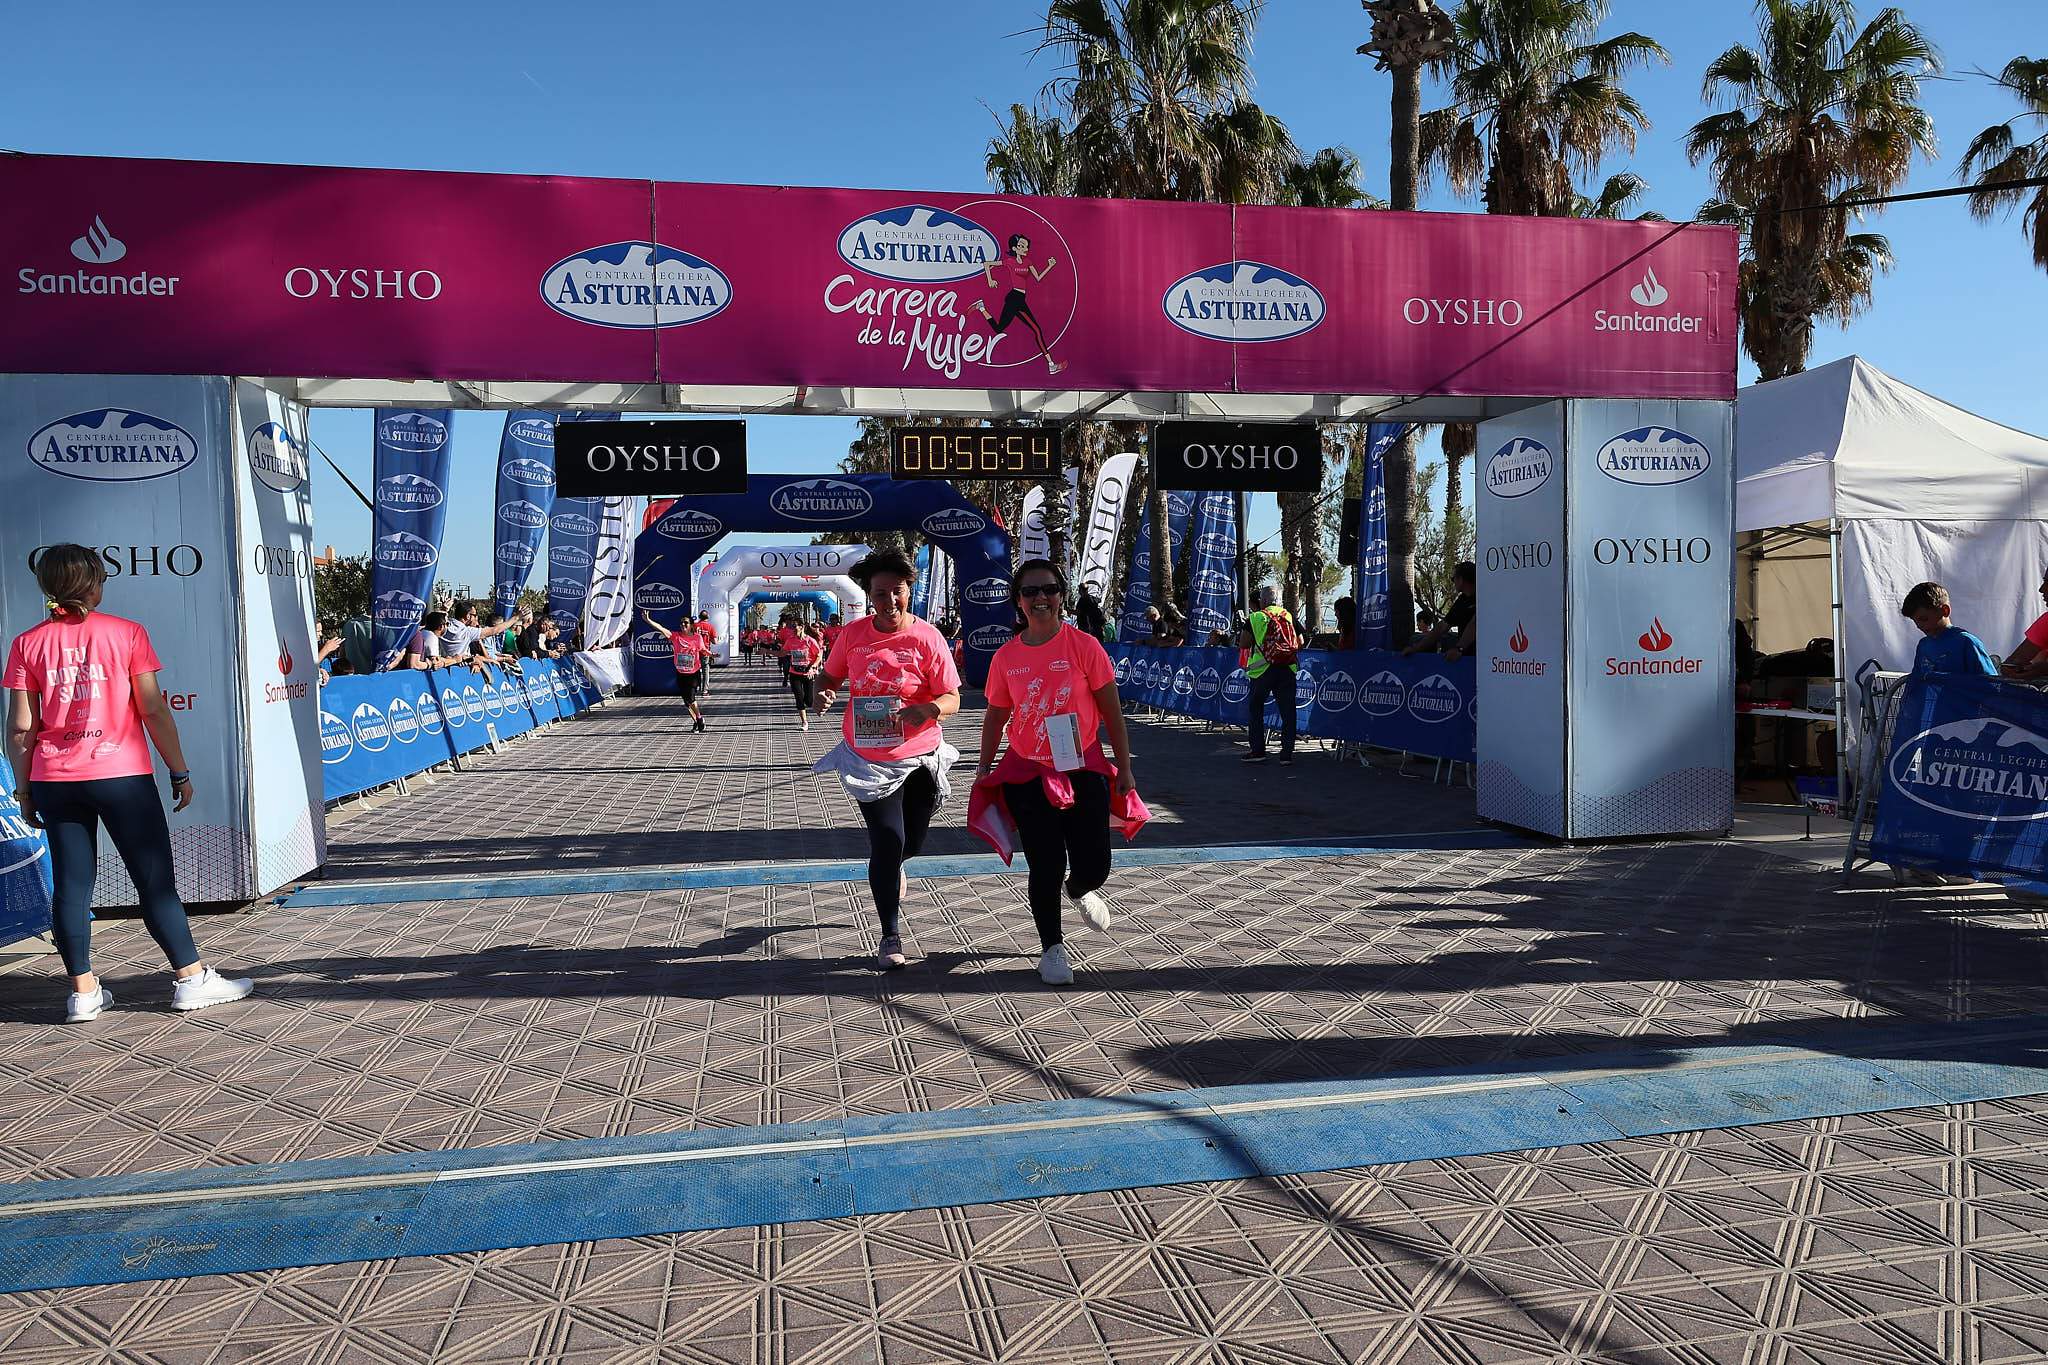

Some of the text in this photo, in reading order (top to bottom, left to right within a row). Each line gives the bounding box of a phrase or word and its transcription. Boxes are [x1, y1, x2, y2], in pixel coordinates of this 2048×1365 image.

[875, 230, 983, 242] CENTRAL LECHERA
[851, 231, 988, 264] ASTURIANA
[17, 268, 180, 296] Santander
[284, 267, 442, 300] OYSHO
[585, 271, 645, 280] CENTRAL
[556, 271, 719, 306] ASTURIANA
[824, 274, 958, 318] Carrera
[1201, 288, 1308, 298] CENTRAL LECHERA
[1176, 288, 1314, 322] ASTURIANA
[1402, 297, 1523, 326] OYSHO
[1594, 310, 1702, 333] Santander
[857, 314, 1007, 380] de la Mujer
[67, 433, 180, 442] CENTRAL LECHERA
[381, 426, 443, 444] ASTURIAN
[513, 424, 554, 443] ASTURIA
[41, 435, 186, 464] ASTURIANA
[586, 445, 721, 473] OYSHO
[903, 435, 1049, 470] 00:56:54
[1183, 443, 1299, 470] OYSHO
[1604, 447, 1702, 471] ASTURIANA
[1661, 446, 1699, 454] LECHERA
[1489, 462, 1548, 487] ASTURIANA
[778, 492, 865, 511] ASTURIANA
[554, 518, 595, 533] ASTURIANA
[660, 520, 717, 534] ASTURIANA
[927, 520, 981, 532] ASTURIANA
[28, 545, 204, 577] SHO
[254, 544, 308, 579] OYSHO
[760, 551, 841, 569] OYSHO
[1486, 541, 1552, 572] OYSHO
[1593, 537, 1712, 565] OYSHO
[552, 586, 585, 596] STURIANA
[635, 593, 681, 605] ASTURIANA
[968, 588, 1011, 599] ASTURIAN
[636, 641, 675, 653] ASTURIAN
[971, 634, 1016, 646] ASTURIAN
[63, 648, 86, 665] TU
[1491, 656, 1547, 677] Santander
[1605, 656, 1703, 677] Santander
[46, 663, 109, 687] DORSAL
[1007, 667, 1031, 676] OYSHO
[59, 686, 102, 704] SUMA
[264, 682, 308, 704] Santander
[1361, 687, 1401, 706] ASTURIANA
[1411, 692, 1455, 713] ASTURIANA
[321, 733, 352, 751] TURIANA
[356, 722, 389, 742] ASTURIANA
[1934, 748, 2048, 769] CENTRAL LECHE
[1899, 747, 2048, 801] ASTURIAN
